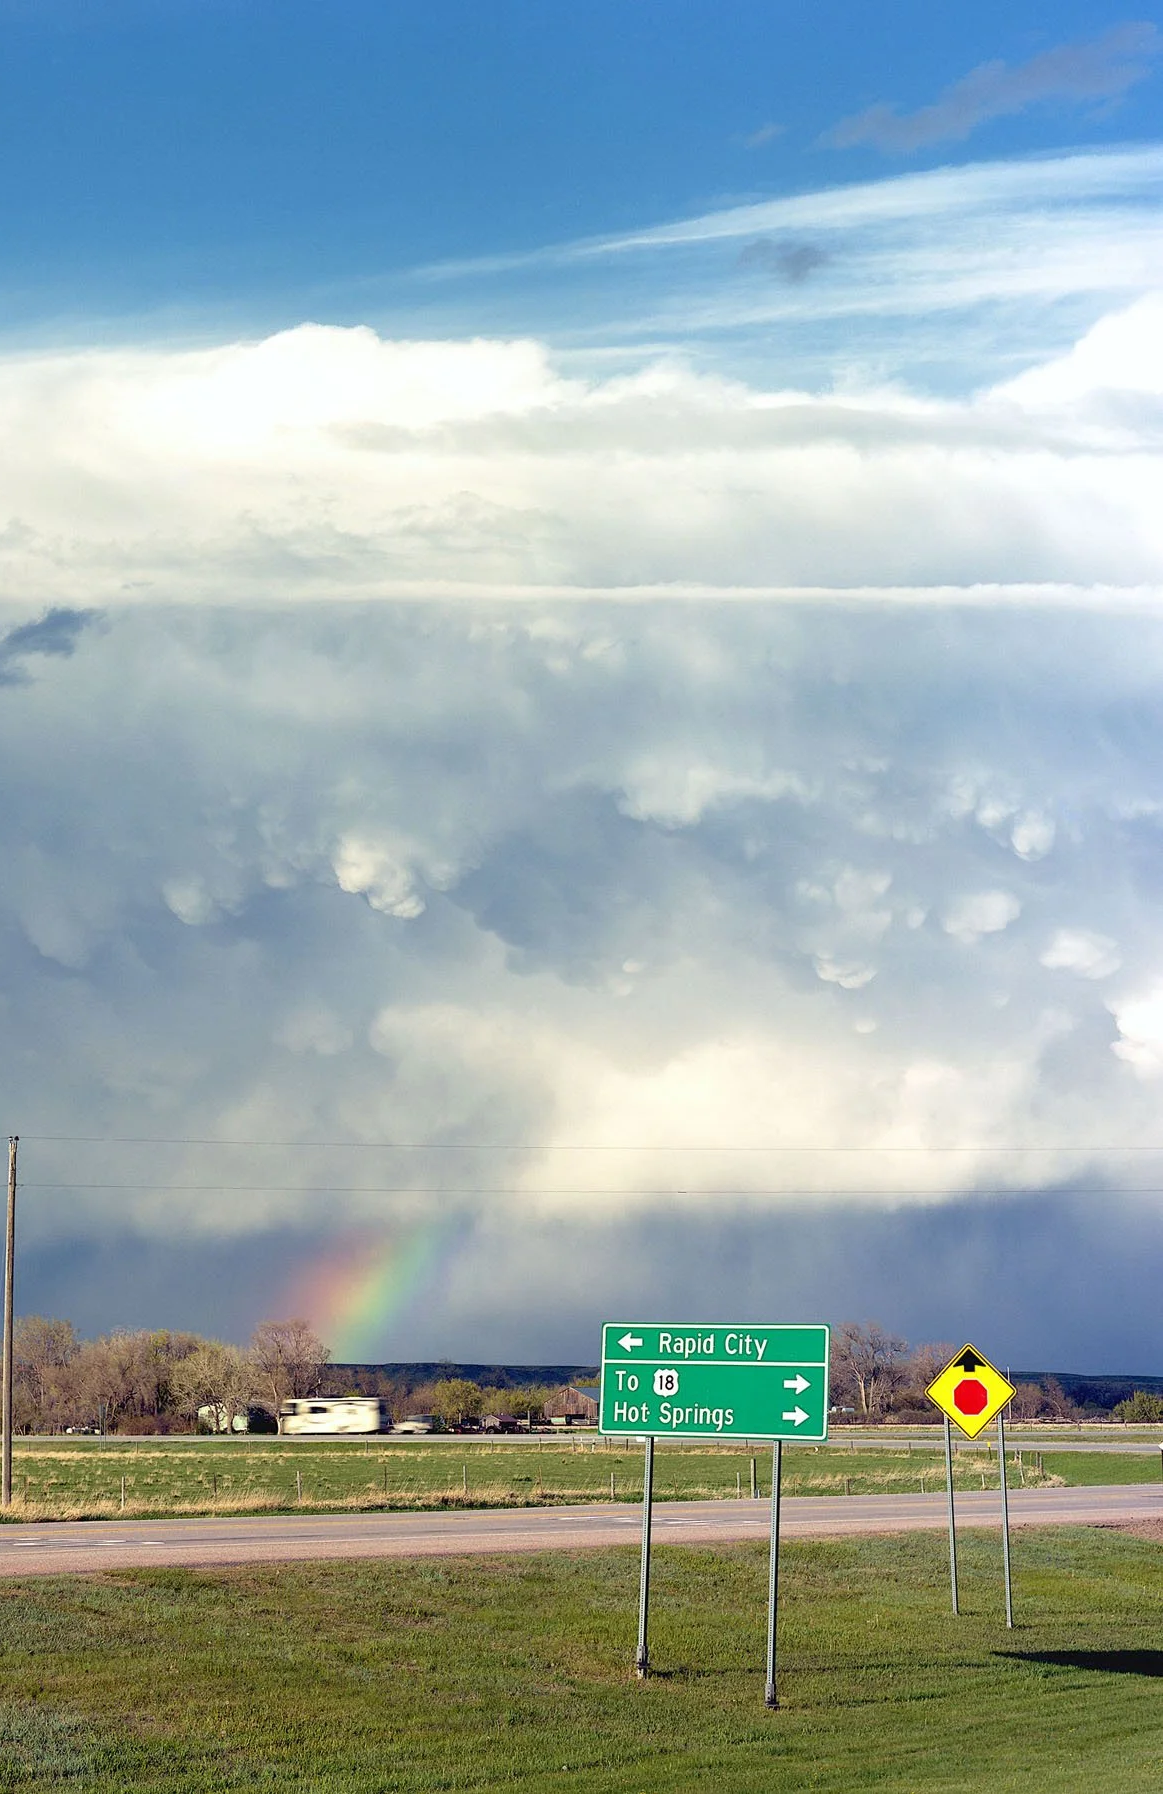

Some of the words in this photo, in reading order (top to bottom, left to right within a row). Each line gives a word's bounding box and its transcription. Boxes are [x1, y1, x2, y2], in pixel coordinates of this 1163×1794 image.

[659, 1332, 715, 1359] Rapid
[724, 1333, 768, 1361] City
[615, 1370, 639, 1392] To
[658, 1374, 674, 1391] 18
[613, 1401, 649, 1423] Hot
[658, 1402, 734, 1432] Springs
